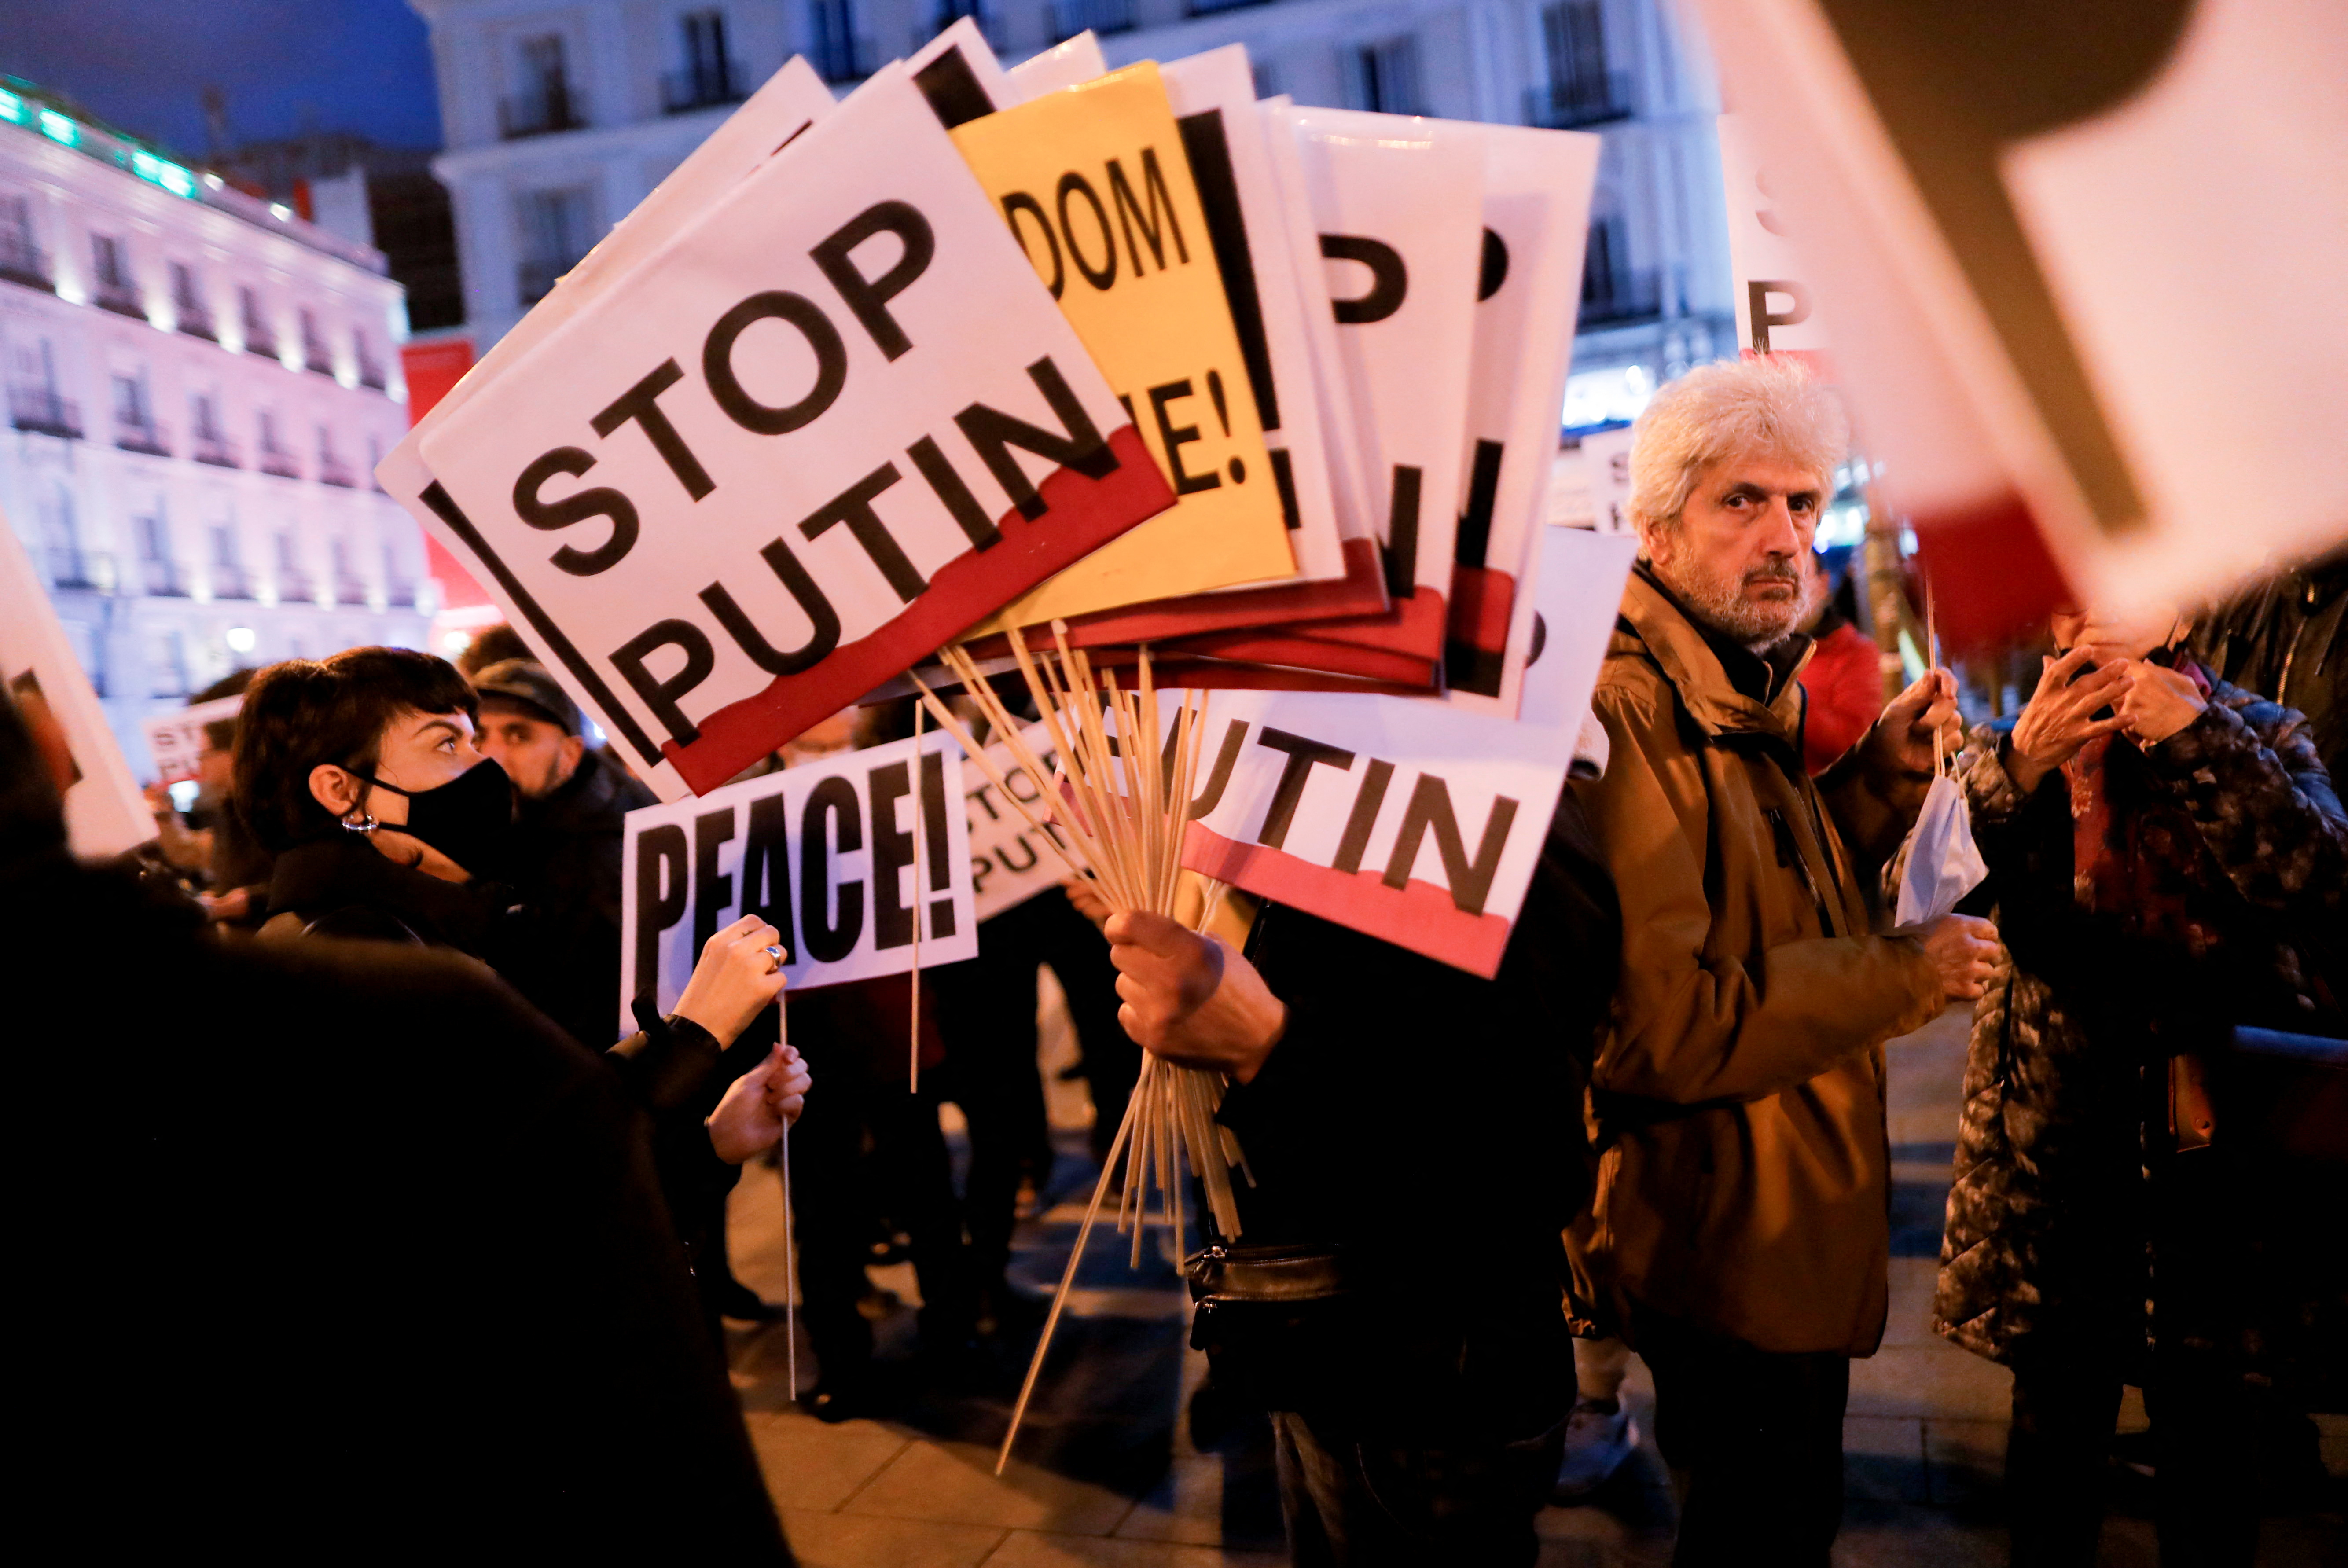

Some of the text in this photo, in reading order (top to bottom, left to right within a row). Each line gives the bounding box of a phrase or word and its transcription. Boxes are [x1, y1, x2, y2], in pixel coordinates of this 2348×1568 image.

[512, 199, 936, 577] STOP
[607, 354, 1121, 748] PUTIN
[634, 749, 956, 1007] PEACE!
